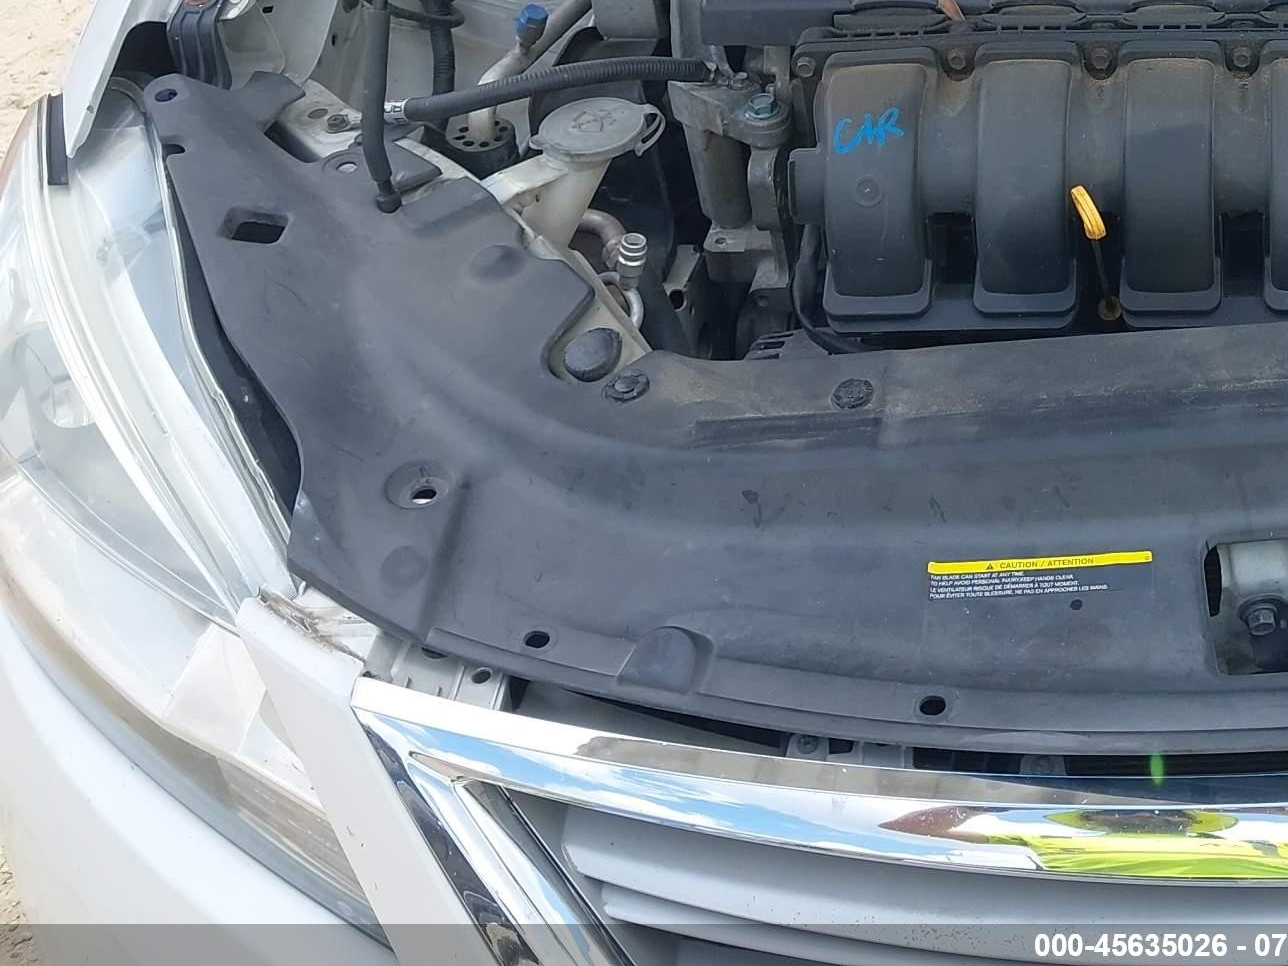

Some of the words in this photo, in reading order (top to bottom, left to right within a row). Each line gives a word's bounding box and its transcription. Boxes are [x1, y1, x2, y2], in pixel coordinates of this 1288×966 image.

[832, 106, 905, 155] CAR
[999, 561, 1038, 570] CAUTION
[1047, 557, 1094, 567] ATTENTION
[946, 591, 965, 599] ÉVITER
